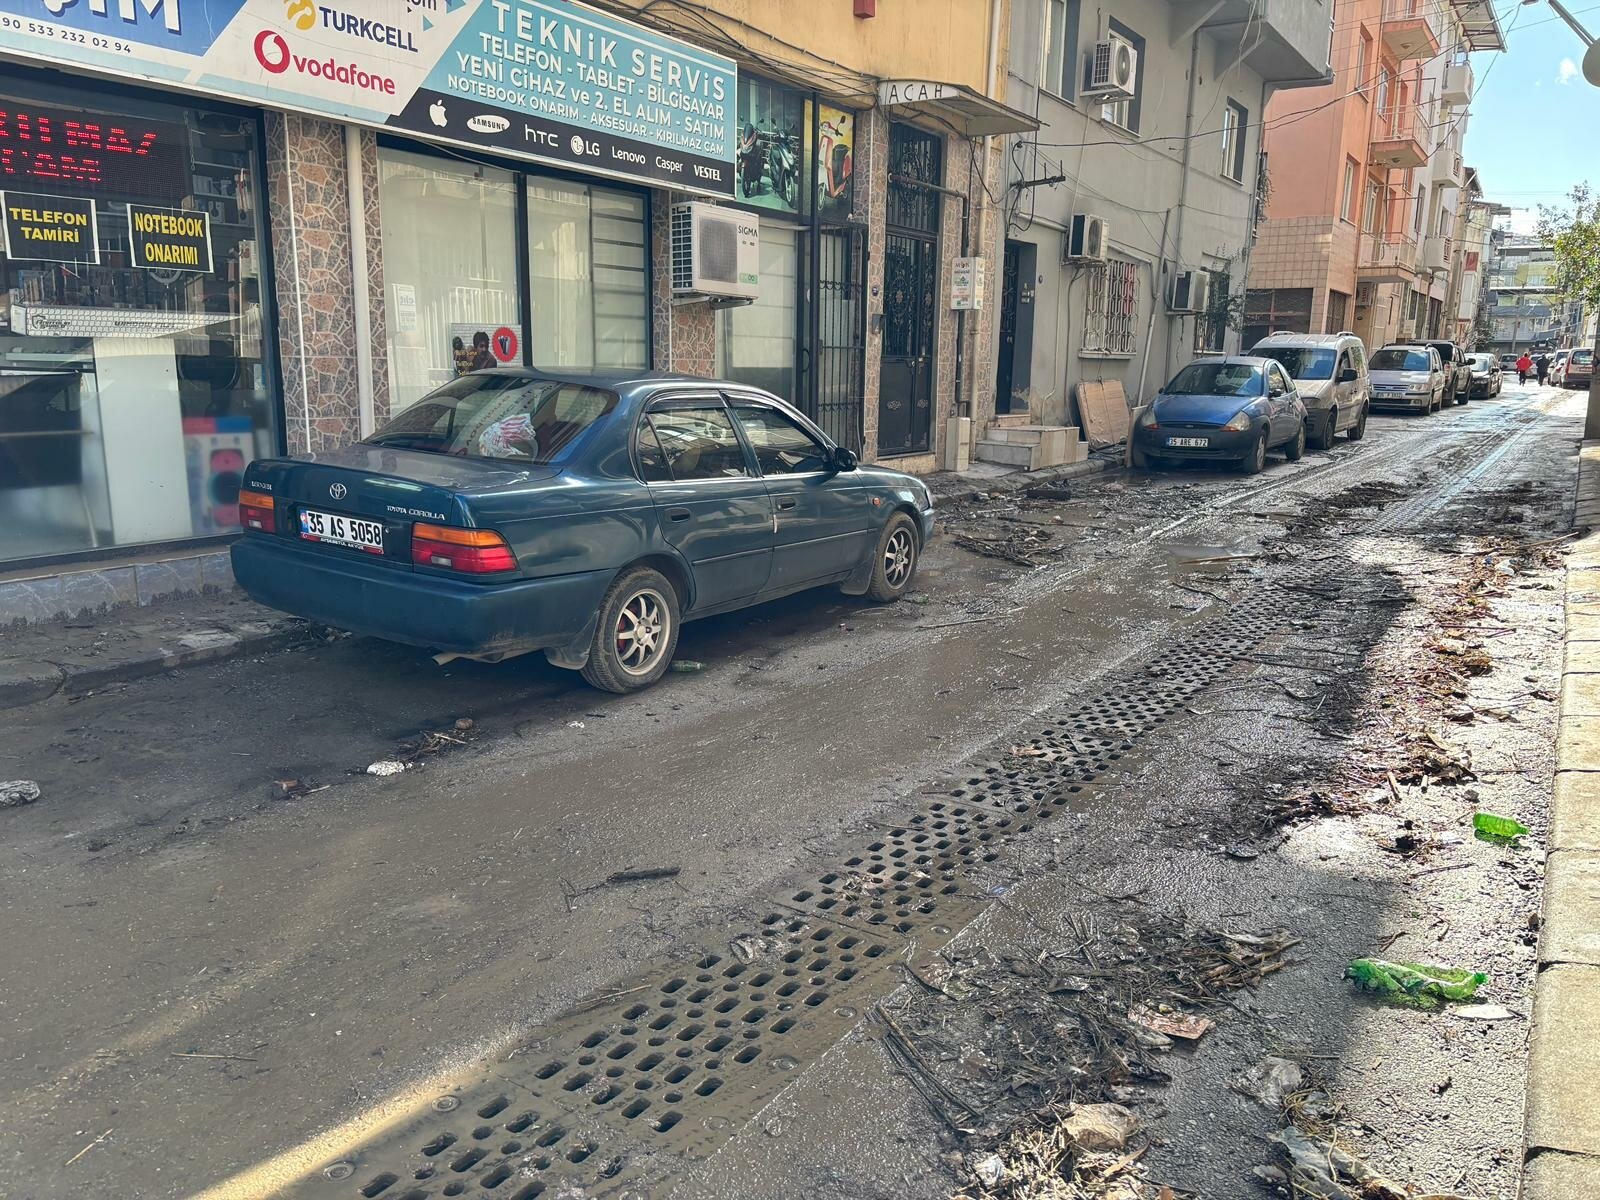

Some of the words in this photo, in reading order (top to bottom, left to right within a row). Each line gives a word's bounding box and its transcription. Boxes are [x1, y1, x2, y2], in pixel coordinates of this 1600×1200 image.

[29, 23, 54, 36] 533
[61, 30, 86, 44] 232
[92, 37, 109, 49] 02
[115, 42, 131, 54] 94
[319, 6, 418, 53] TURKCELL
[292, 54, 395, 95] vodafone
[479, 31, 562, 75] TELEFON
[577, 62, 635, 95] TABLET
[648, 83, 724, 121] BİLGİSAYAR
[447, 73, 526, 107] NOTEBOOK
[529, 96, 579, 119] ONARIM
[590, 112, 647, 137] AKSESUAR
[656, 129, 702, 150] KIRILMAZ
[571, 88, 590, 105] ve
[594, 91, 608, 111] 2.
[614, 96, 631, 117] EL
[636, 103, 671, 127] ALIM
[685, 117, 724, 141] SATIM
[472, 117, 505, 131] SAMSUNG
[585, 140, 600, 156] LG
[612, 146, 646, 165] Lenovo
[655, 156, 683, 173] Casper
[693, 165, 722, 181] VESTEL
[9, 207, 87, 226] TELEFON
[134, 212, 203, 237] NOTEBOOK
[738, 225, 758, 237] SIGMA
[20, 226, 79, 243] TAMİRİ
[145, 243, 198, 265] ONARIMI
[308, 513, 324, 534] 35
[330, 517, 345, 538] AS
[350, 520, 381, 545] 5058
